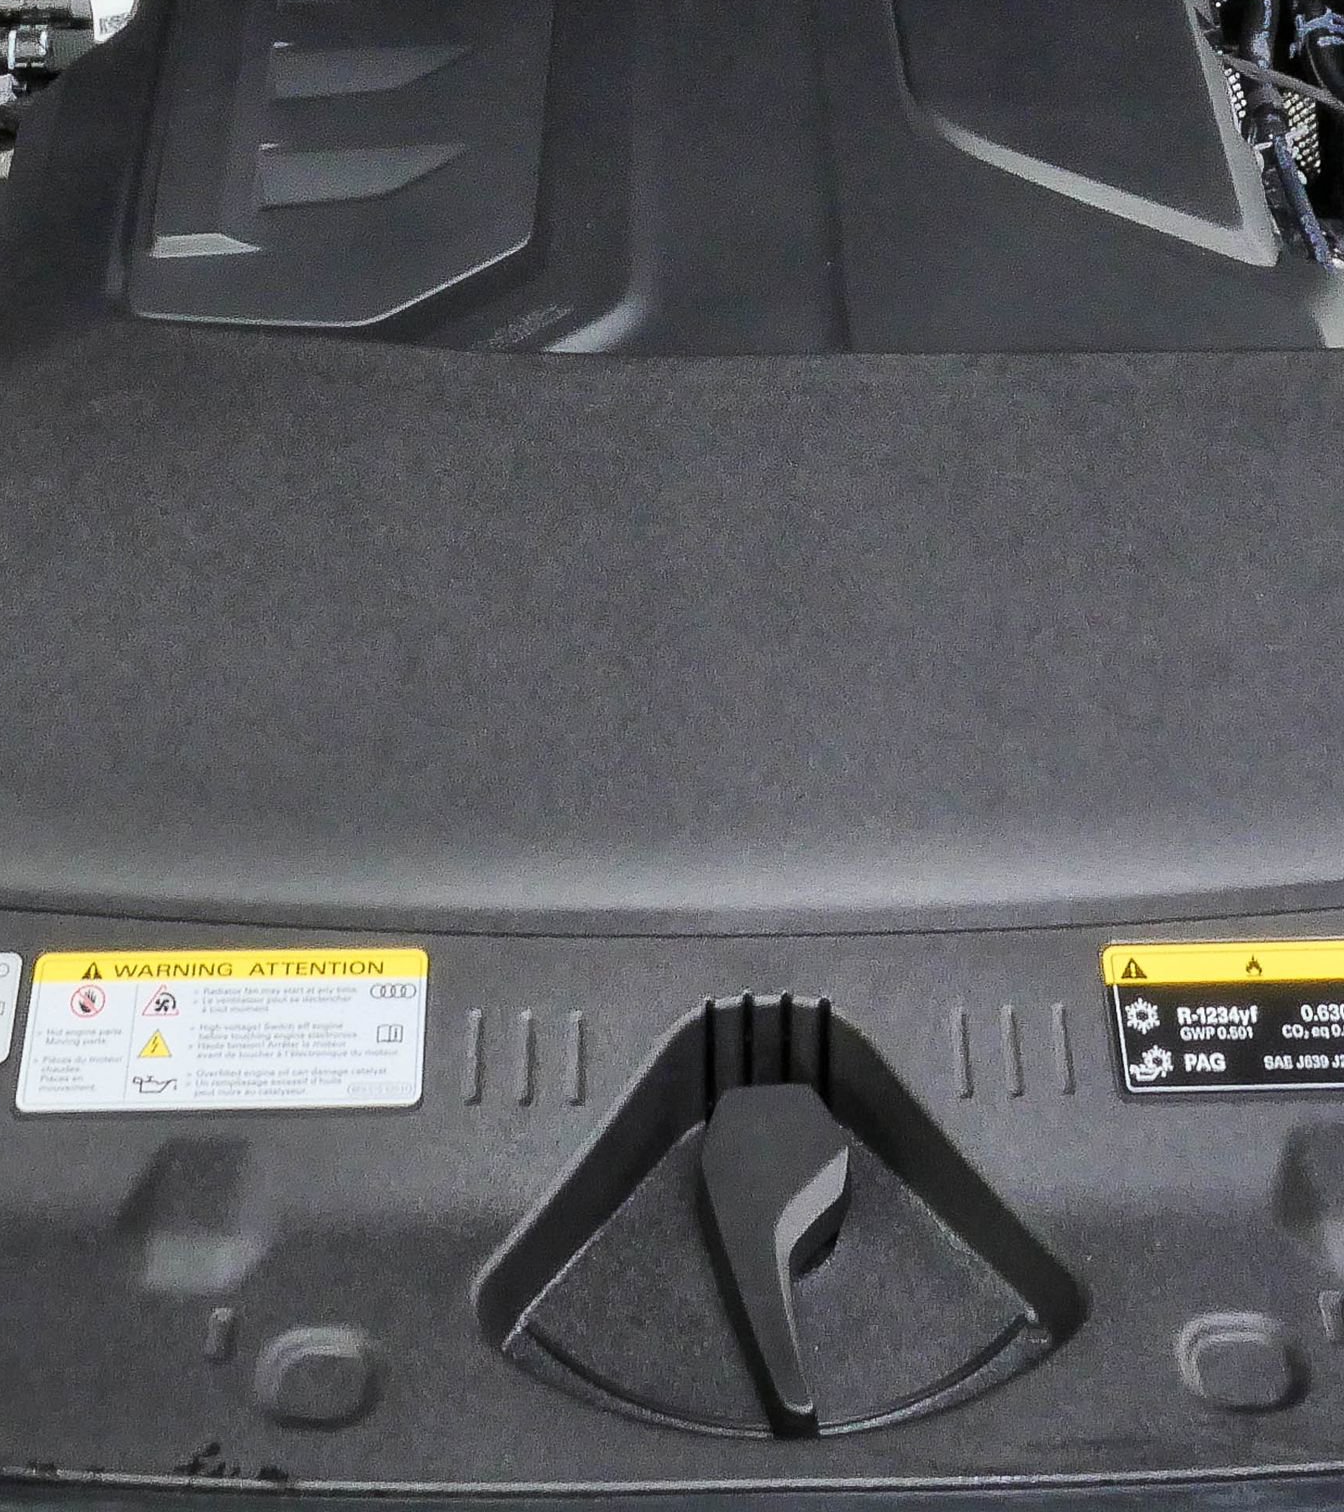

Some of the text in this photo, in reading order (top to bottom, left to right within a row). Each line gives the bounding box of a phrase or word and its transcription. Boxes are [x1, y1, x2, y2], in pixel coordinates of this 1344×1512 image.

[114, 962, 384, 977] WARNING ATTENTION
[1177, 1006, 1258, 1026] R-1234yf
[1181, 1026, 1215, 1041] GWP
[1311, 1026, 1329, 1039] eq
[1184, 1053, 1226, 1071] PAG
[1264, 1056, 1294, 1069] SAE
[1296, 1054, 1329, 1069] J639
